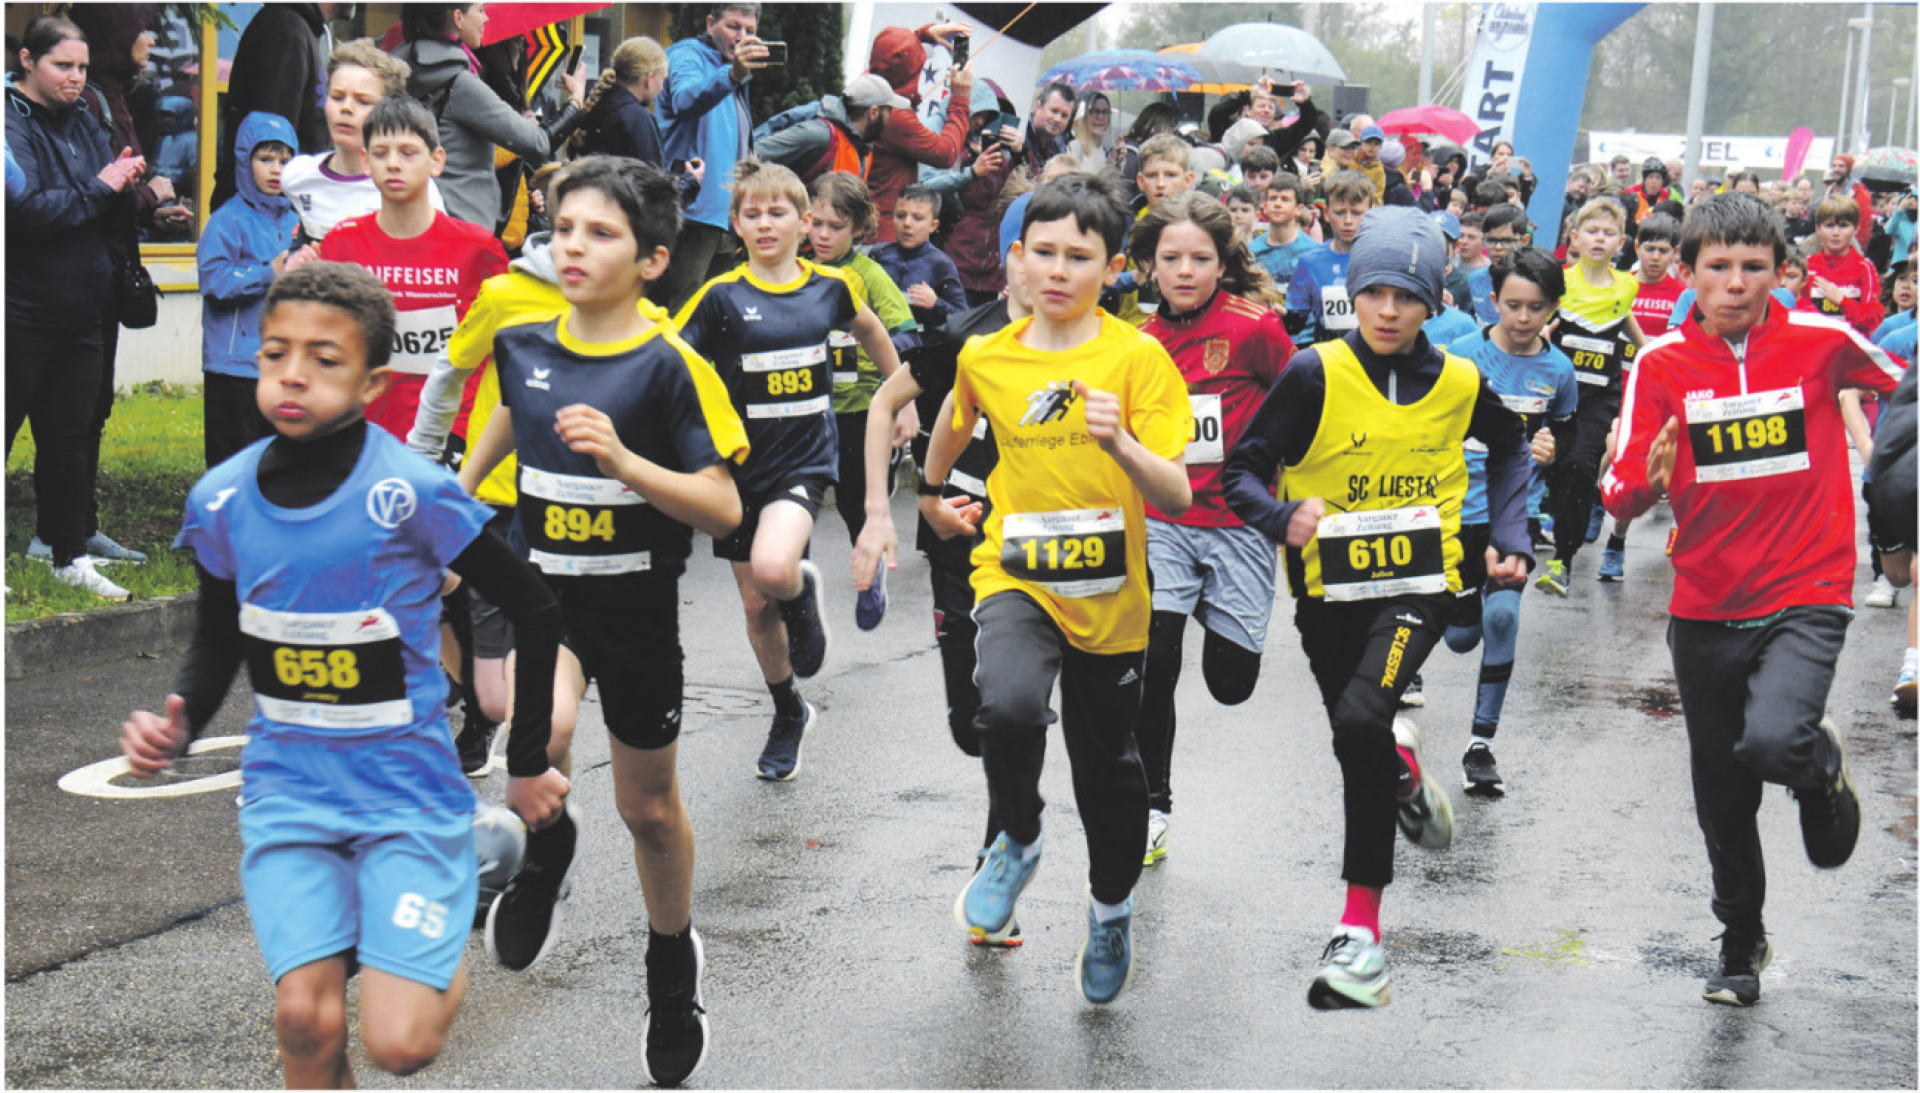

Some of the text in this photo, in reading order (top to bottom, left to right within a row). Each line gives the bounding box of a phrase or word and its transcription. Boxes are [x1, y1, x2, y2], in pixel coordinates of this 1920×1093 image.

[1573, 350, 1605, 370] 870
[767, 368, 813, 396] 893
[1707, 415, 1788, 453] 1198
[1347, 474, 1369, 503] SC
[544, 504, 615, 542] 894
[1020, 535, 1106, 571] 1129
[1348, 534, 1413, 571] 610
[273, 646, 360, 689] 658
[392, 892, 449, 939] 65
